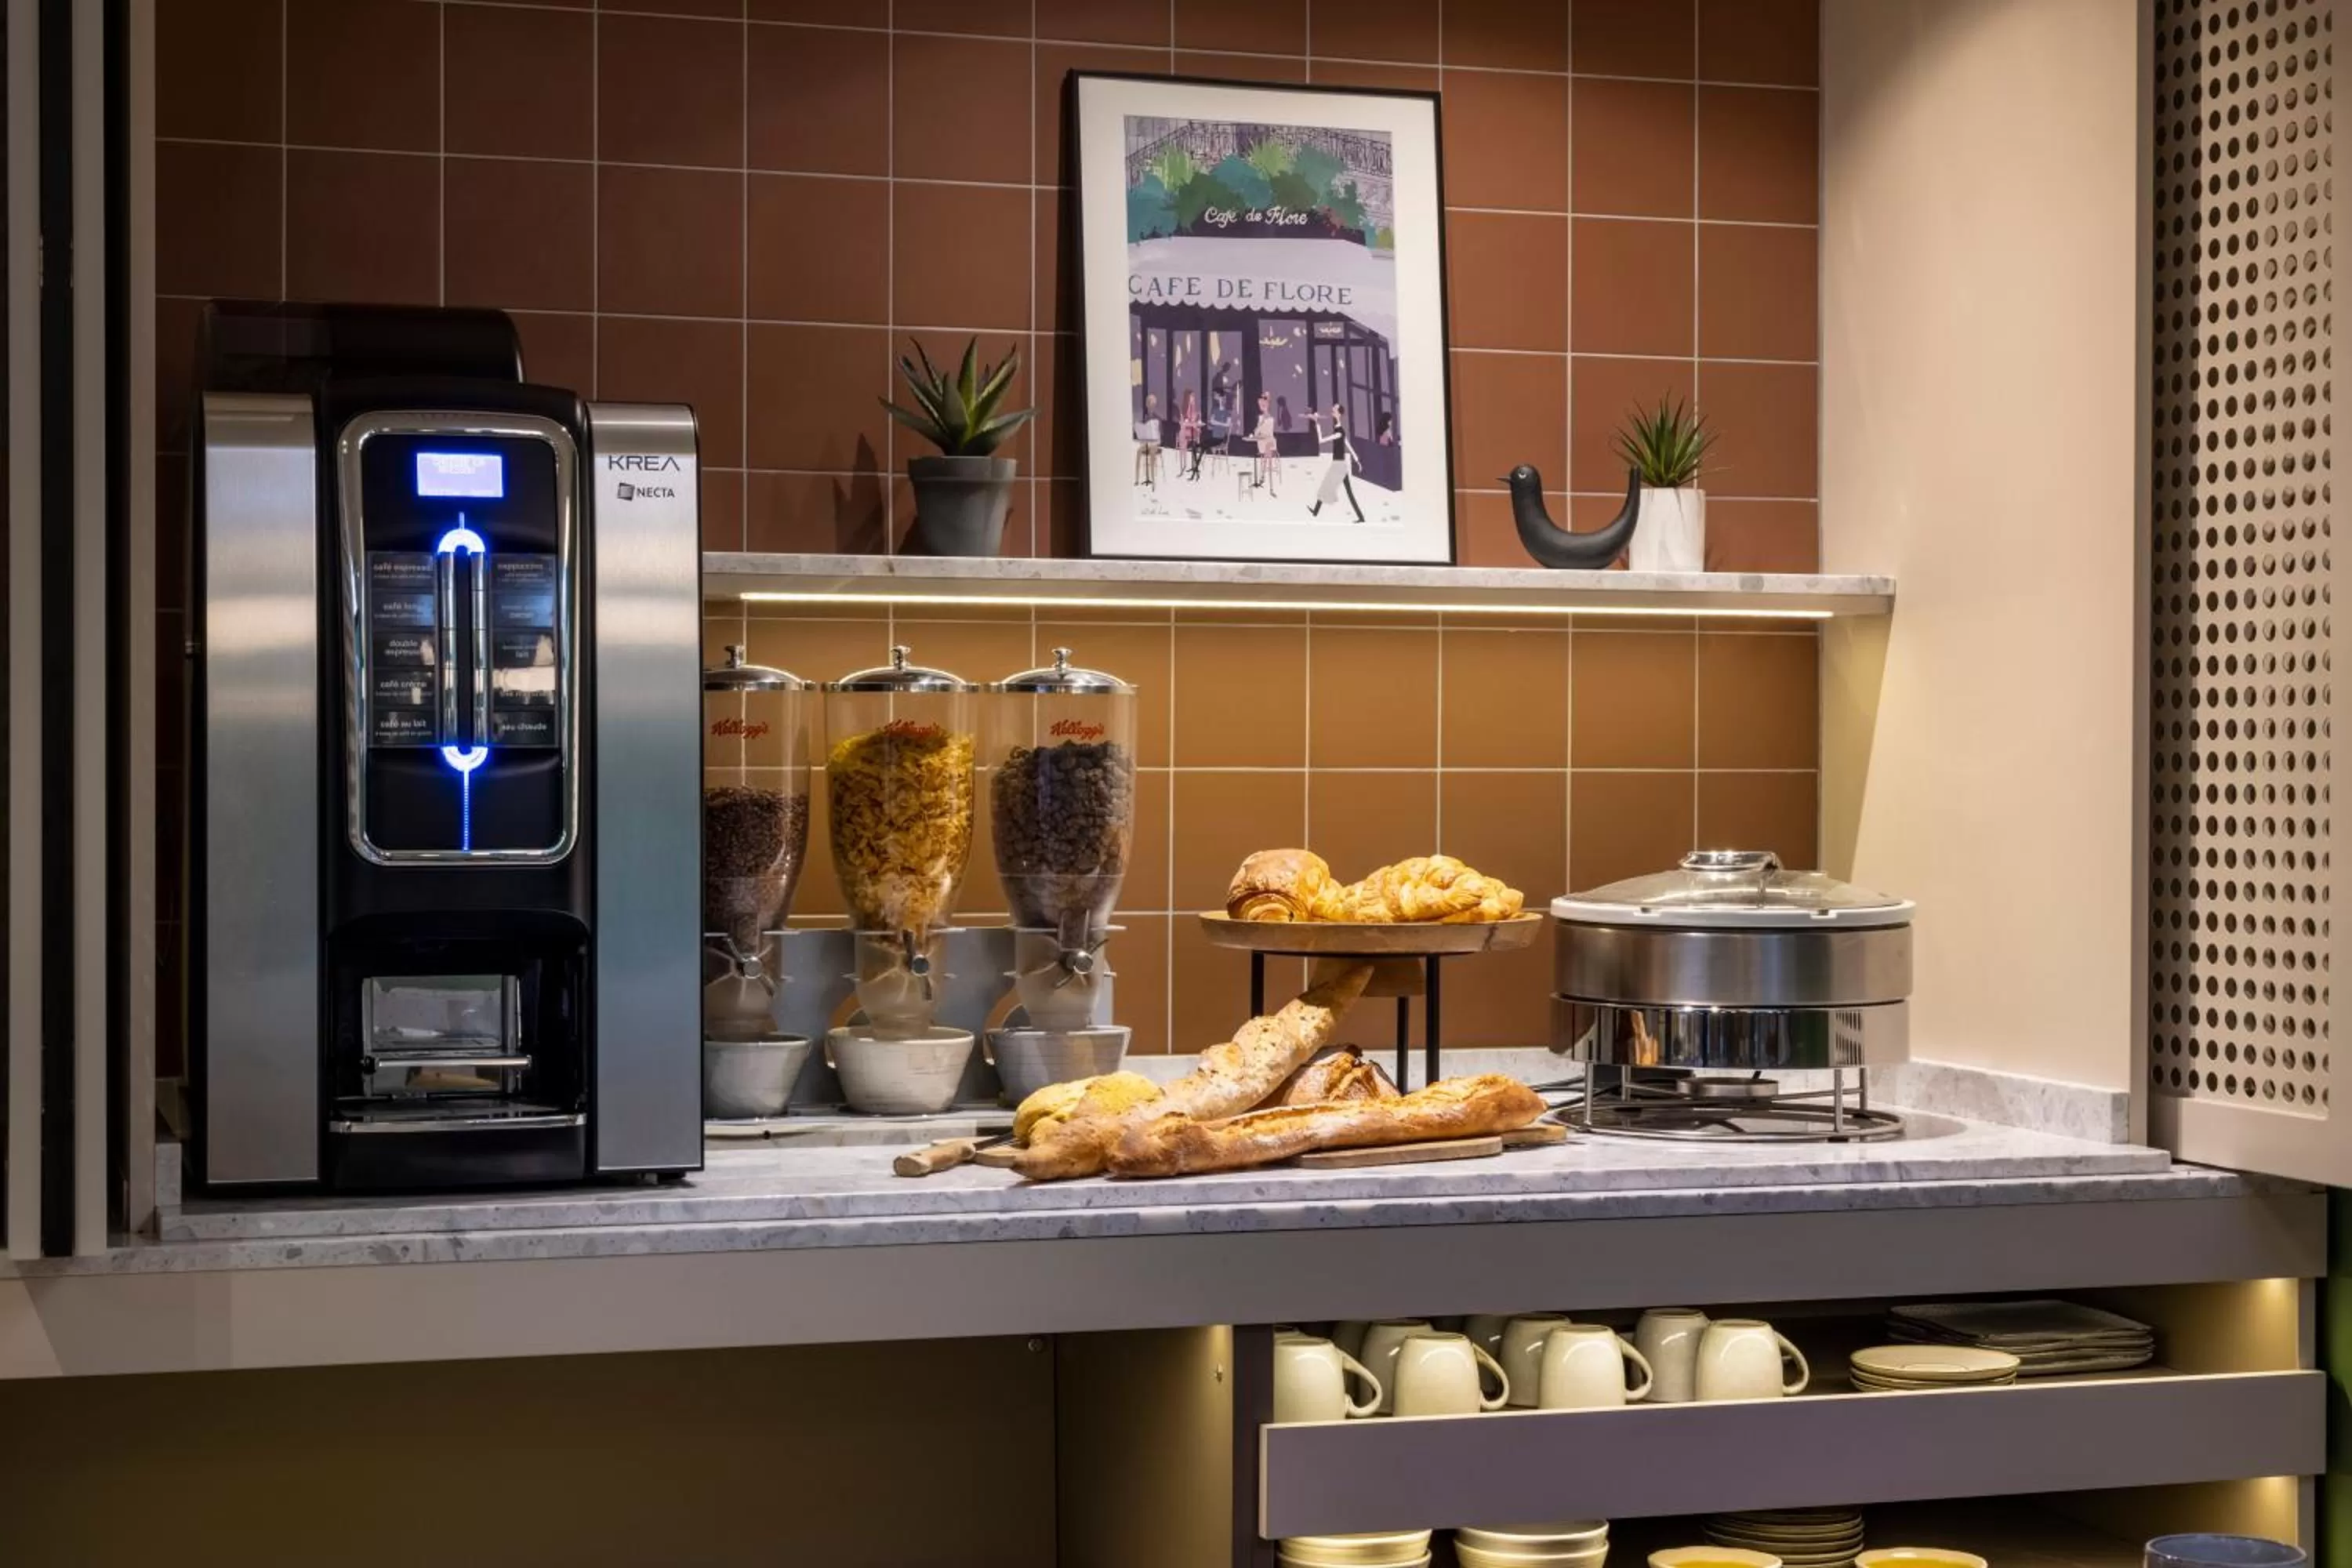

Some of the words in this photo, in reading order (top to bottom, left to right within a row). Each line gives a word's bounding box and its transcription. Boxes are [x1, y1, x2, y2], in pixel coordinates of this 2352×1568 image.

[1245, 207, 1262, 222] de
[1265, 205, 1308, 226] Flore
[1127, 274, 1202, 297] CAFE
[1217, 278, 1252, 299] DE
[1264, 281, 1352, 305] FLORE
[608, 456, 681, 471] KREA
[637, 487, 676, 498] NECTA
[1050, 719, 1105, 740] Kellogg's
